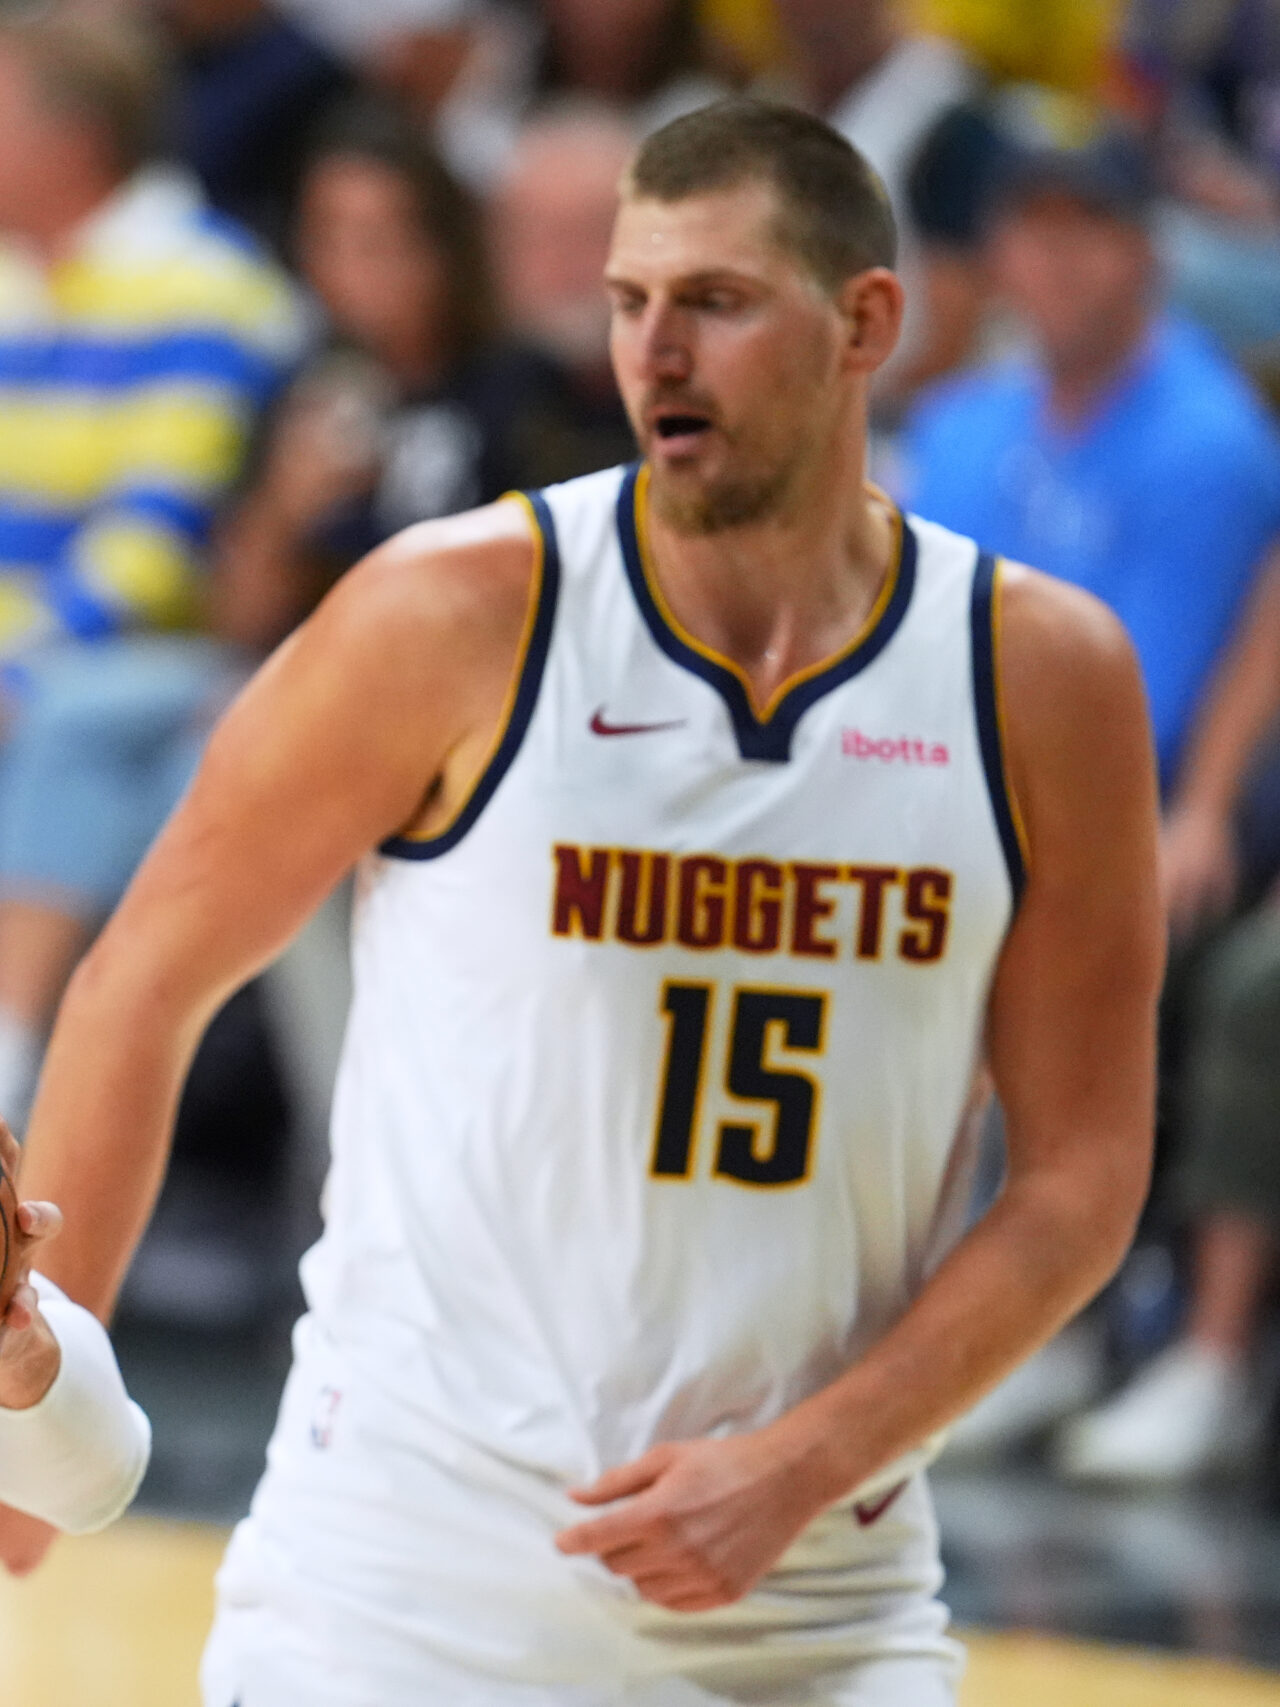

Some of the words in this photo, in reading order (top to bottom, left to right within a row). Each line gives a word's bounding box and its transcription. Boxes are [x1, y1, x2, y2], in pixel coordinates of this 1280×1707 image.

[841, 728, 950, 766] ibotta
[550, 841, 955, 966] NUGGETS
[648, 975, 833, 1191] 15
